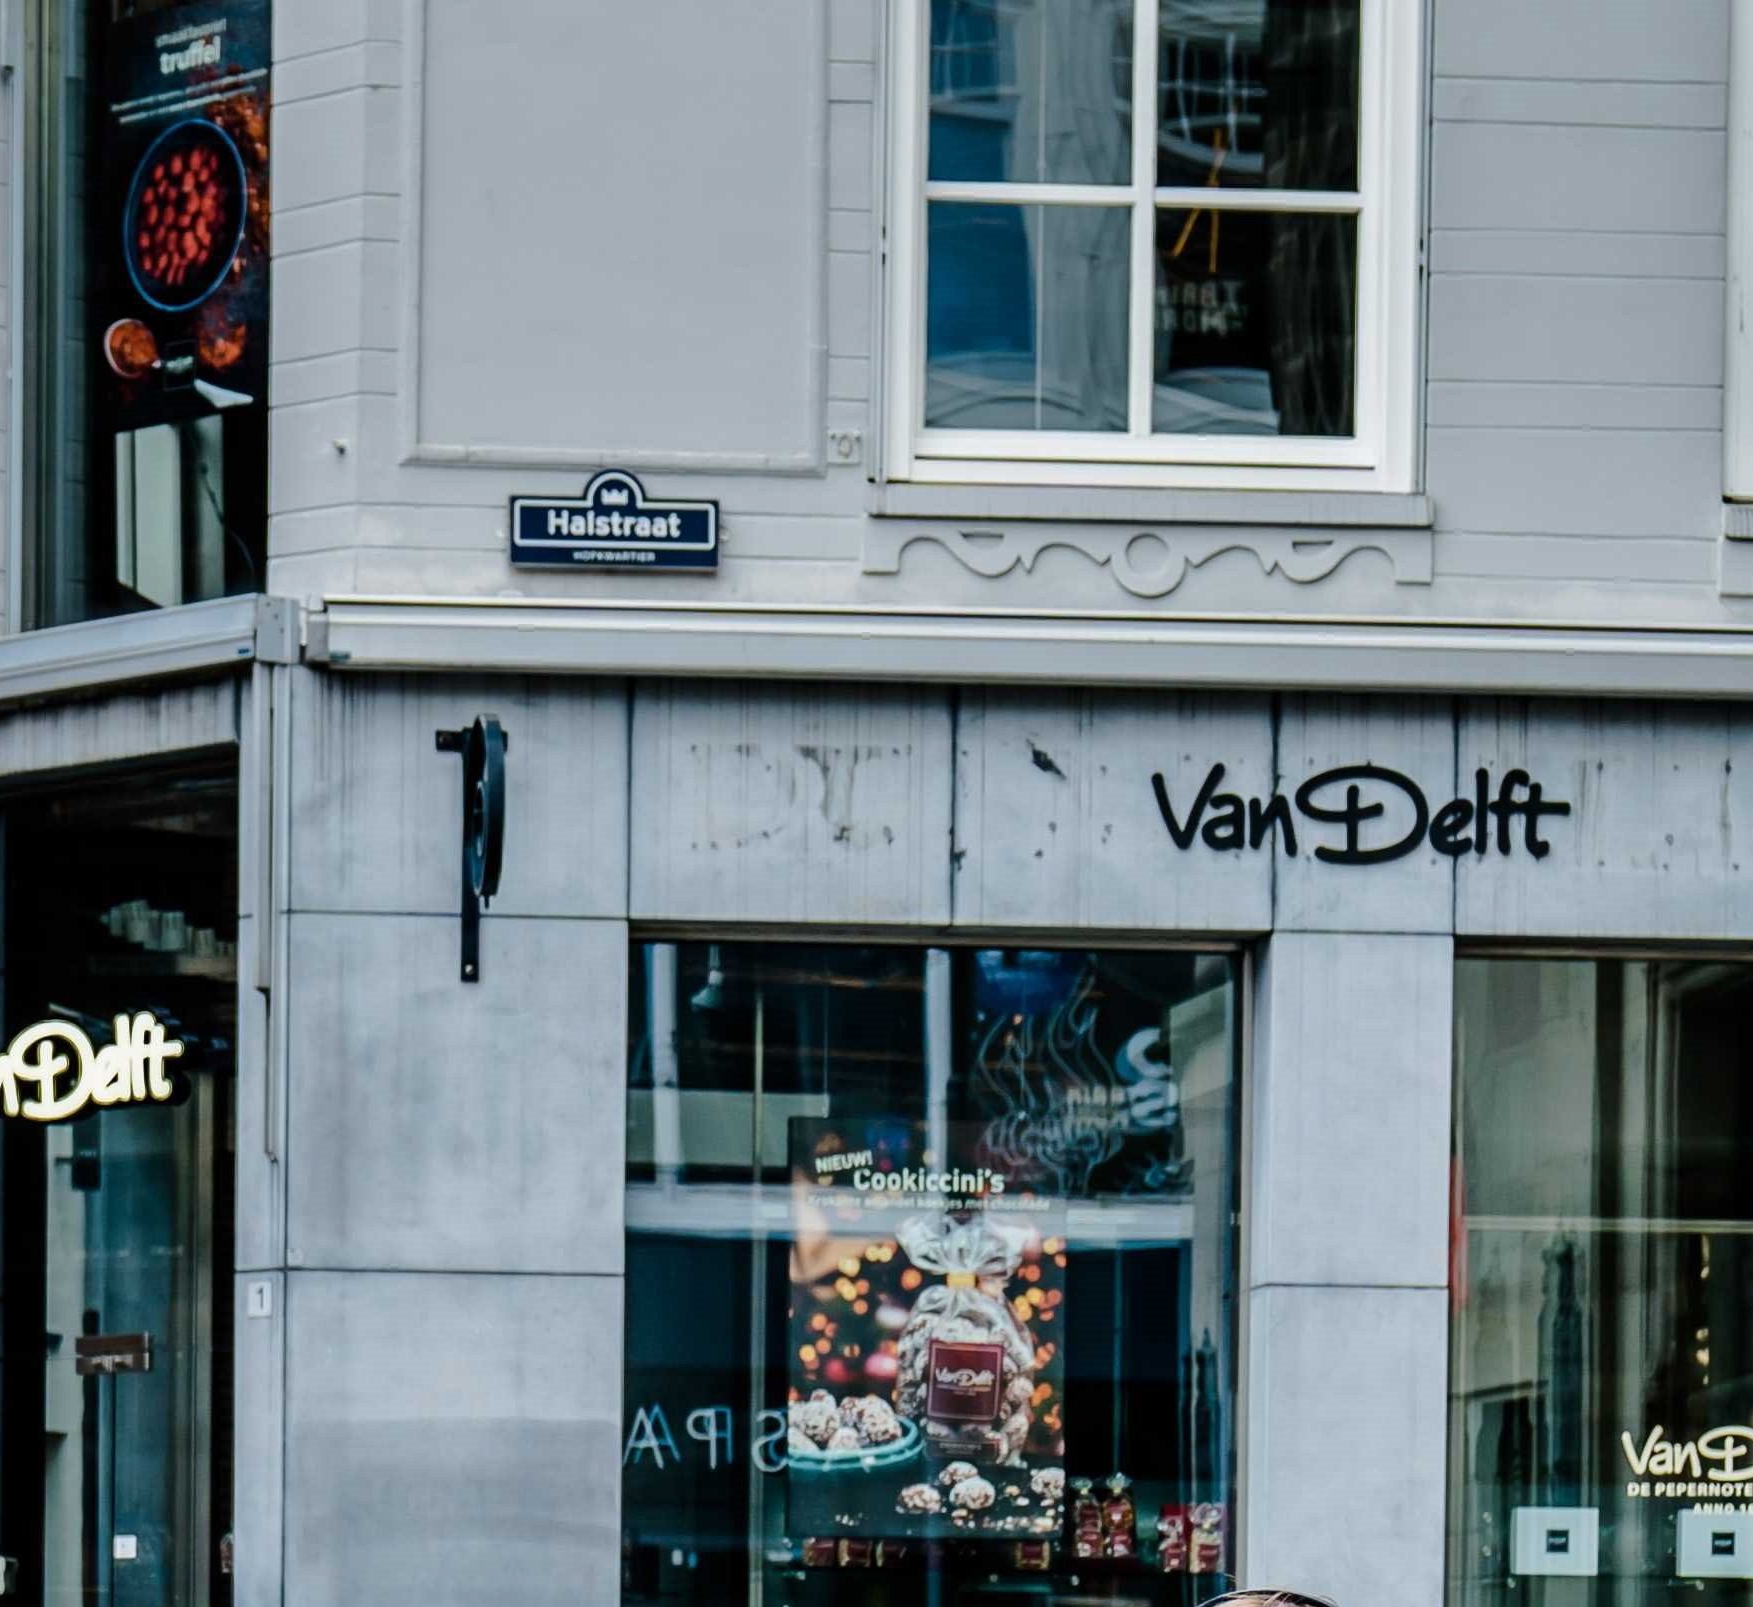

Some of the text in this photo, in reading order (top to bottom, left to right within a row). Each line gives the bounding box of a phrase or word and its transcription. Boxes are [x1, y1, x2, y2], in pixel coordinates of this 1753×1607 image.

[547, 509, 681, 538] Halstraat
[815, 1150, 873, 1174] NIEUW!
[853, 1167, 1005, 1194] Cookiccini's
[1627, 1482, 1650, 1497] DE
